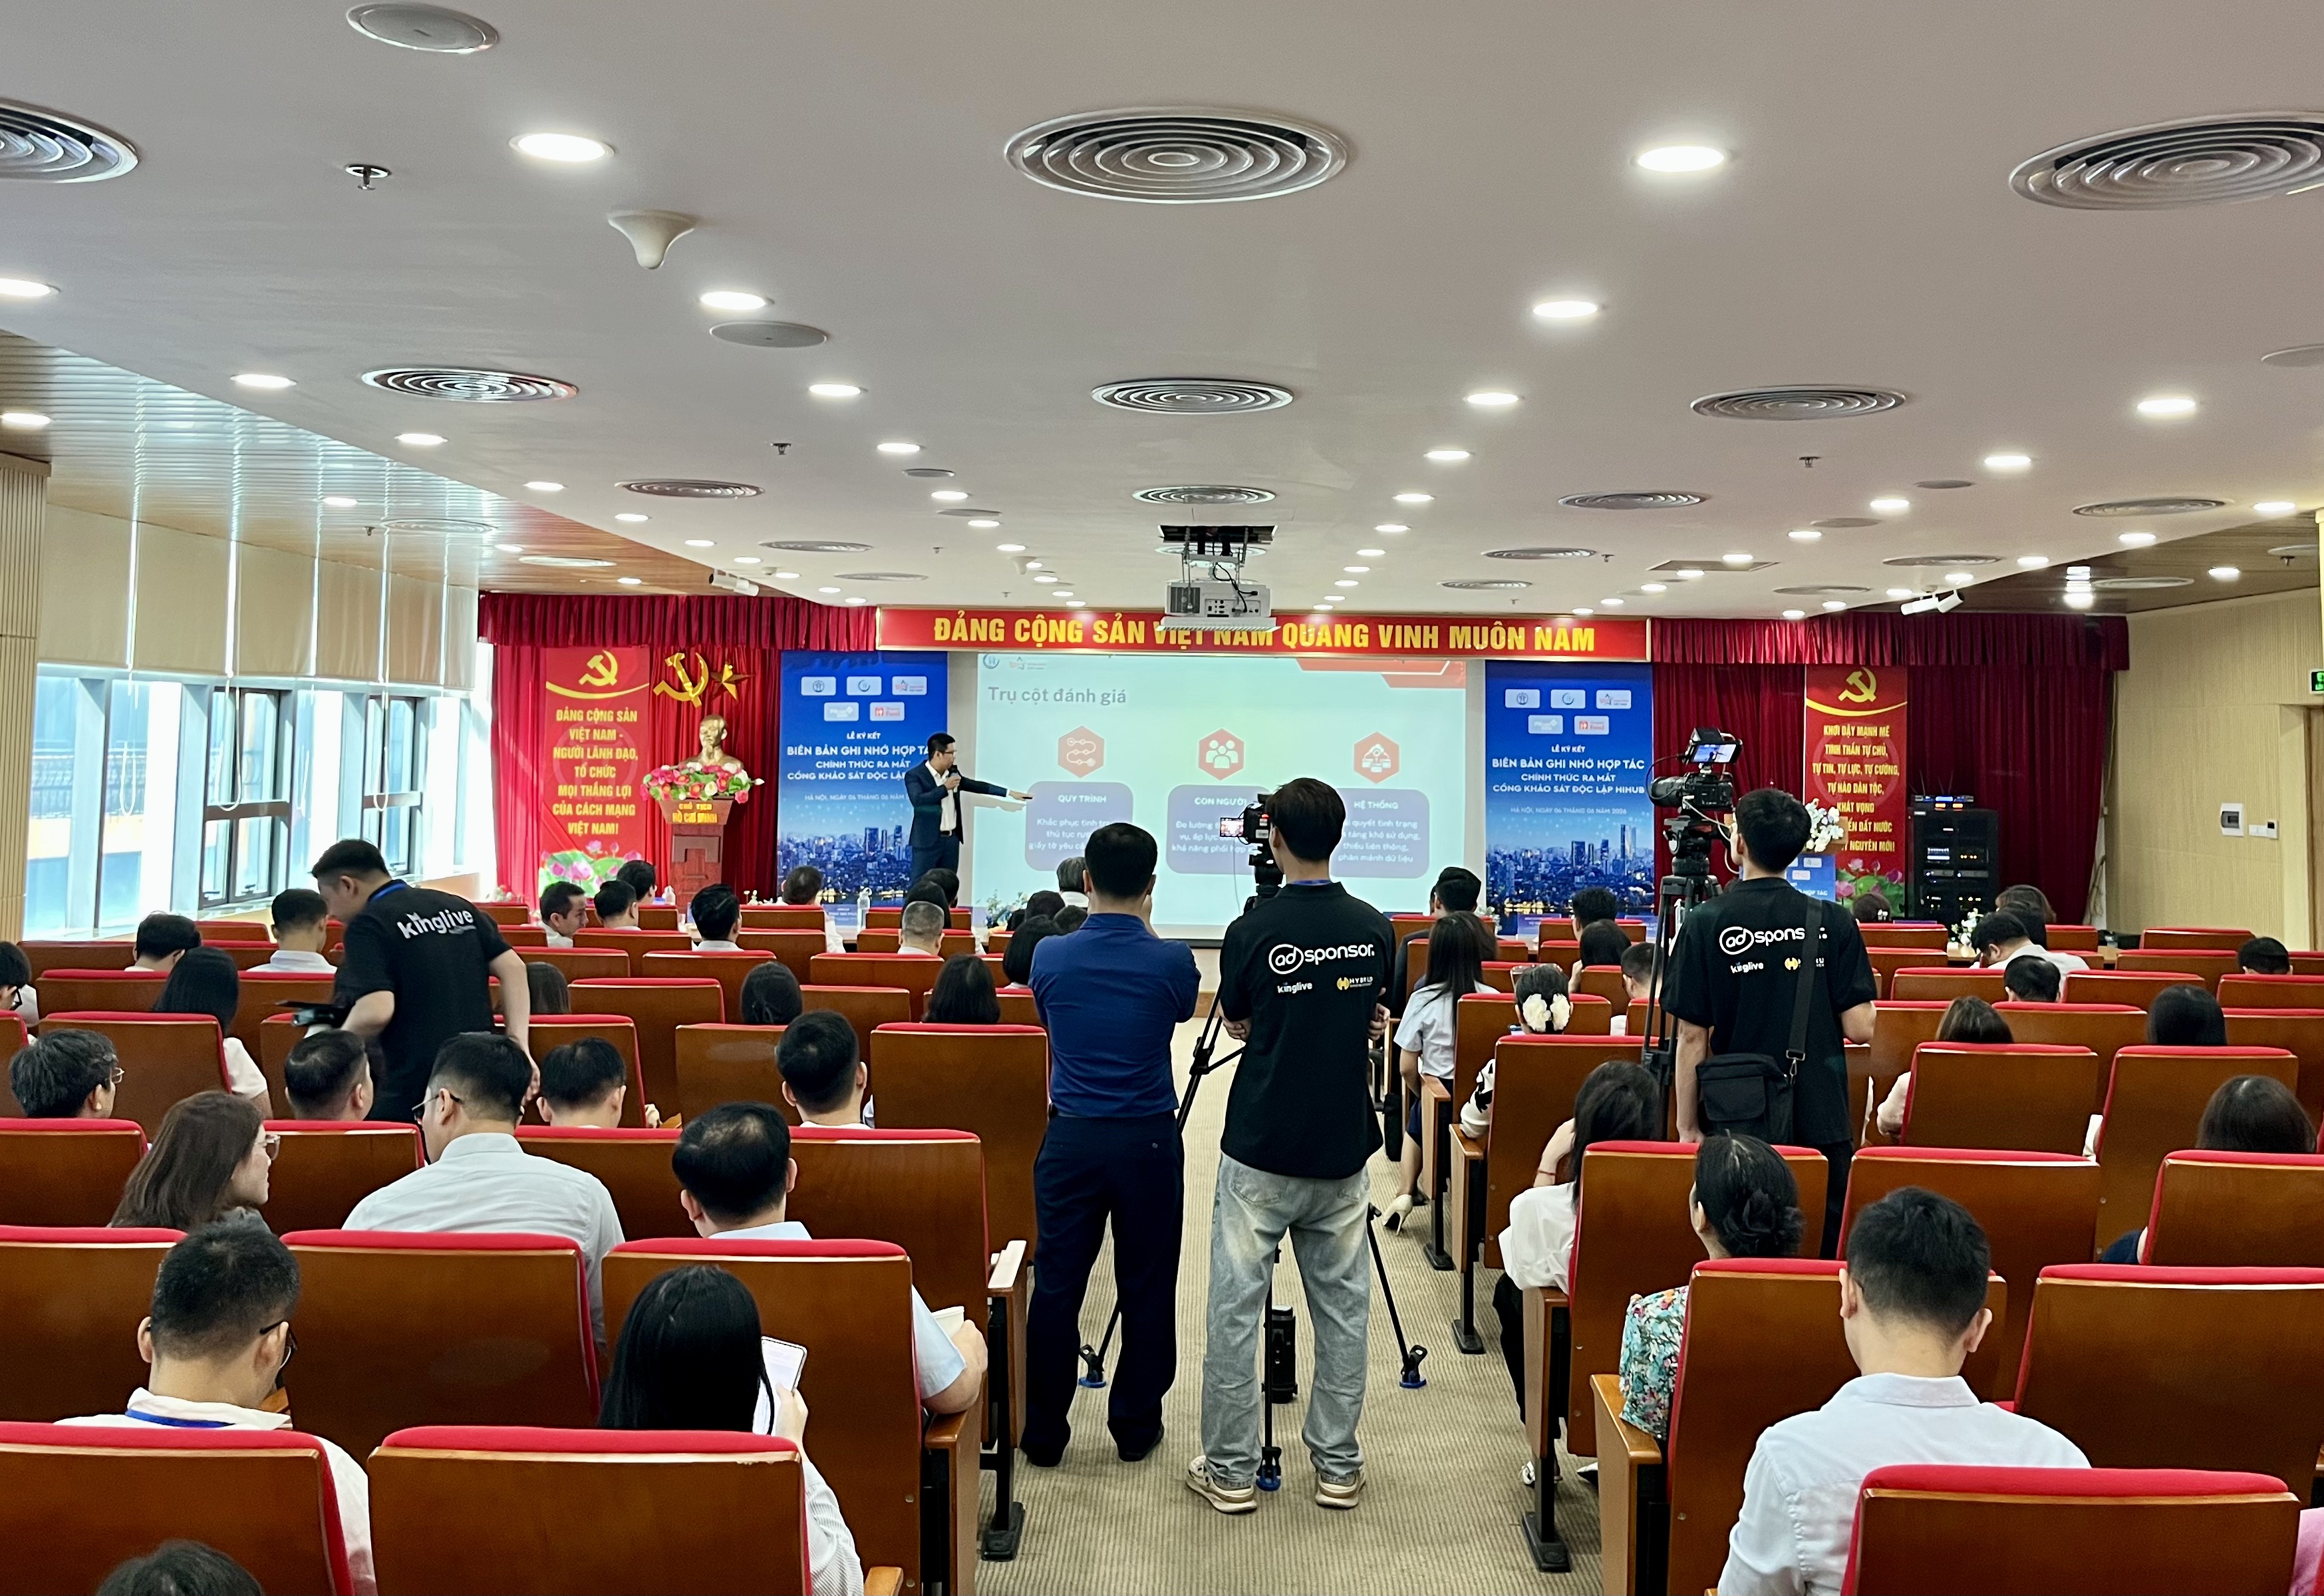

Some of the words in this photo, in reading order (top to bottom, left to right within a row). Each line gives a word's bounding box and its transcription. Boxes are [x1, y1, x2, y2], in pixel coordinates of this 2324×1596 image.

[934, 610, 1005, 641] ĐẢNG
[1014, 613, 1083, 647] CỘNG
[1093, 612, 1145, 644] SẢN
[1282, 622, 1370, 649] QUANG
[1378, 624, 1439, 649] VINH
[1449, 621, 1526, 651] MUÔN
[988, 687, 1016, 705] Trụ
[1022, 689, 1048, 705] cột
[1054, 688, 1095, 703] đánh
[1100, 689, 1126, 706] giá
[556, 707, 583, 721] ĐẢNG
[587, 708, 614, 724] CỘNG
[617, 707, 637, 722] SẢN
[569, 726, 590, 742] VIỆT
[593, 728, 616, 740] NAM
[553, 745, 584, 759] NGƯỜI
[587, 745, 613, 759] LÃNH
[787, 744, 812, 756] BIÊN
[815, 744, 838, 756] BẢN
[841, 746, 861, 755] GHI
[865, 744, 889, 755] NHỚ
[892, 746, 916, 758] HỢP
[815, 760, 847, 768] CHÍNH
[848, 759, 875, 768] THỨC
[1492, 756, 1517, 768] BIÊN
[1520, 756, 1542, 768] BẢN
[1546, 759, 1566, 768] GHI
[1569, 758, 1594, 769] NHỚ
[1597, 760, 1621, 771] HỢP
[1623, 757, 1645, 769] TÁC
[589, 764, 616, 778] CHỨC
[848, 771, 865, 780] SÁT
[1521, 772, 1551, 781] CHÍNH
[1553, 772, 1580, 782] THỨC
[558, 785, 577, 798] MỌI
[616, 786, 631, 799] LỢI
[1554, 784, 1570, 792] SÁT
[1572, 784, 1593, 794] ĐỘC
[1058, 795, 1077, 804] QUY
[553, 800, 573, 816] CỦA
[575, 802, 602, 816] CÁCH
[605, 804, 635, 818] MẠNG
[568, 820, 589, 836] VIỆT
[591, 823, 619, 835] NAM!
[397, 909, 474, 939] kinglive
[1277, 982, 1312, 994] kinglive
